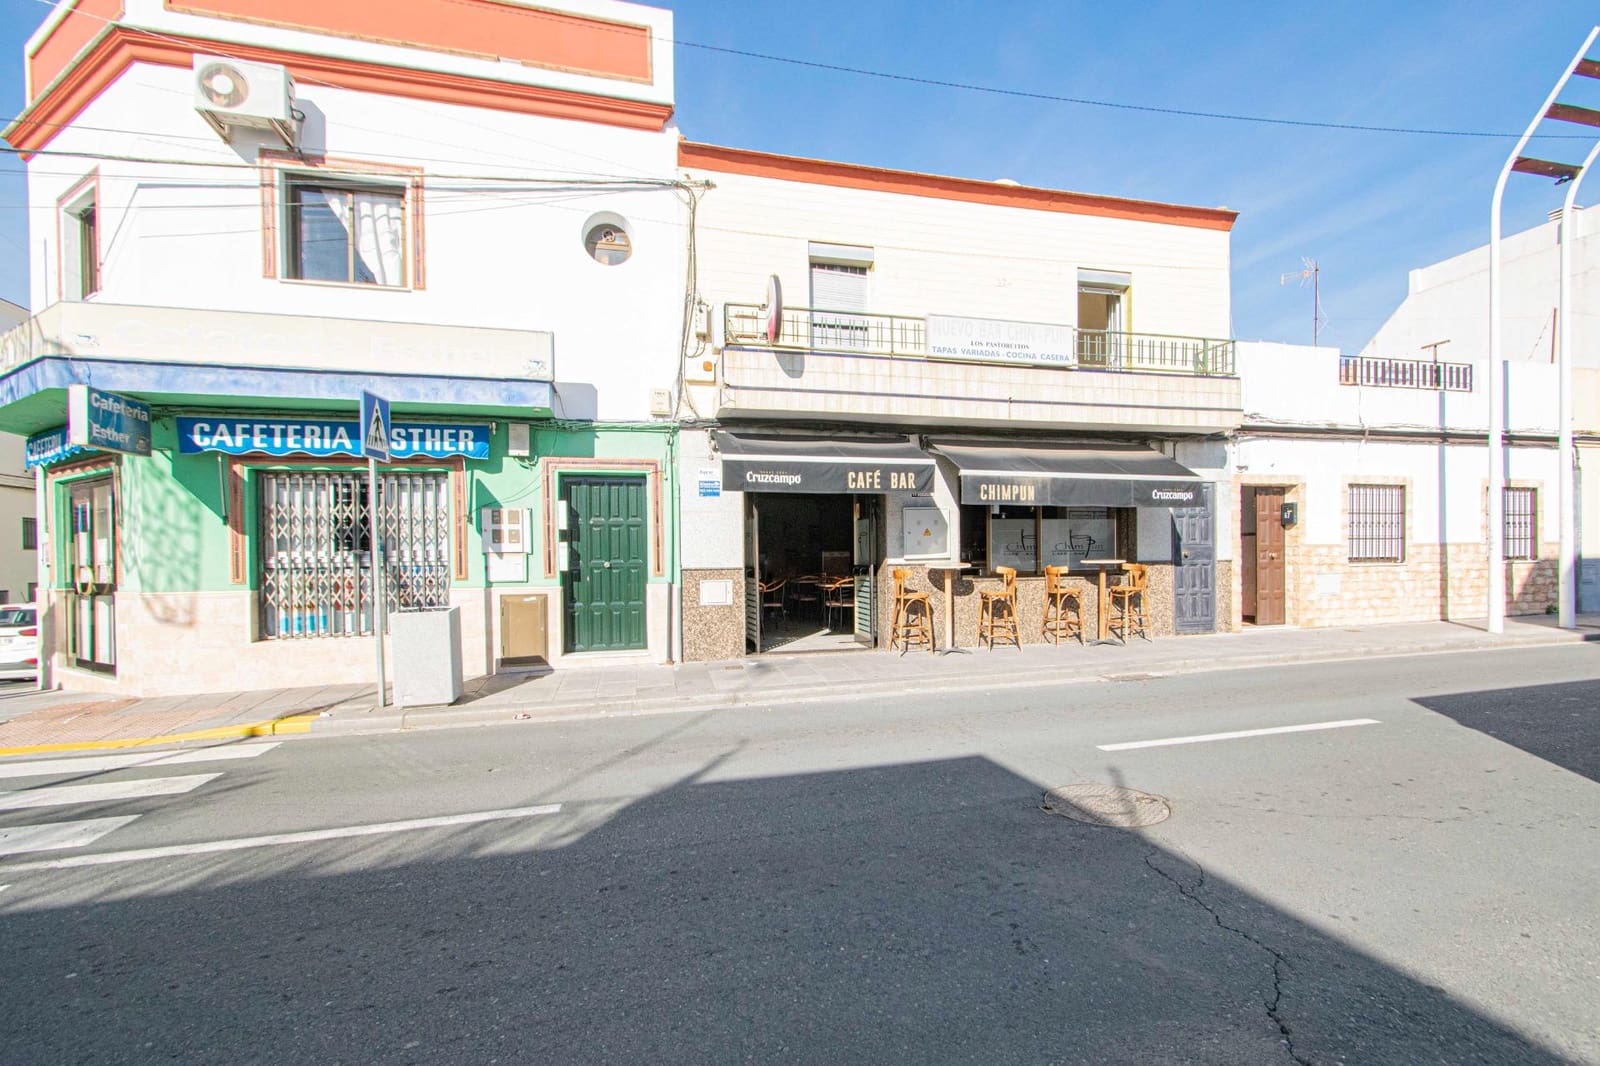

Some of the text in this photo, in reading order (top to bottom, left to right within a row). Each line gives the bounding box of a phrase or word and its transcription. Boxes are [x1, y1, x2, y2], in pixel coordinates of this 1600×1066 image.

[932, 345, 957, 354] TAPAS
[960, 348, 1000, 358] VARIADAS
[1006, 351, 1037, 360] COCINA
[1040, 353, 1070, 362] CASERA
[90, 392, 149, 423] Cafeteria
[92, 423, 130, 444] Esther
[192, 421, 475, 453] CAFETERIA STHER
[746, 470, 802, 486] Cruzcampo
[848, 469, 916, 489] CAFÉ BAR
[980, 483, 1036, 502] CHIMPUN
[1152, 489, 1194, 501] Cruzcampo
